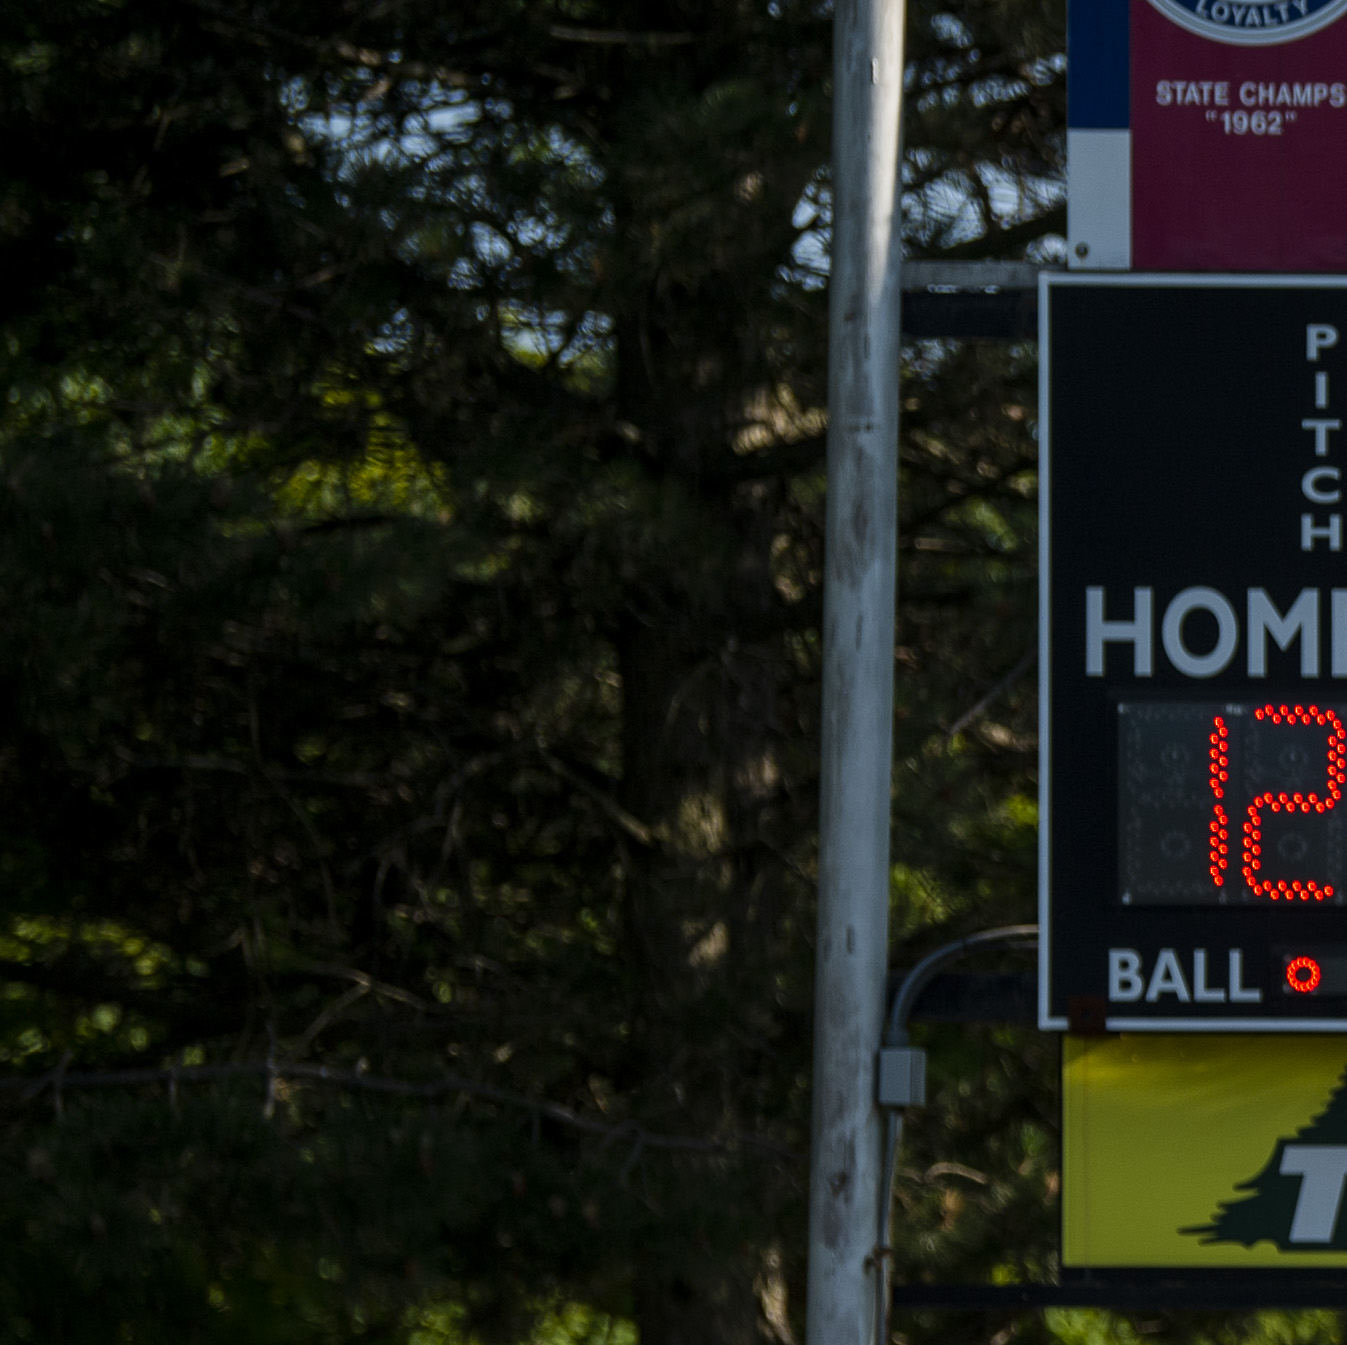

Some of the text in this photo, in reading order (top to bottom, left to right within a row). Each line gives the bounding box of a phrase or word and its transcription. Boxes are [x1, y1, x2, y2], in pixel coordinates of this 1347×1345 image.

[1195, 0, 1308, 28] LOYALTY
[1155, 80, 1347, 108] STATE CHAMPS
[1301, 324, 1342, 551] PITCH
[1208, 704, 1347, 901] 12
[1108, 948, 1261, 1002] BALL
